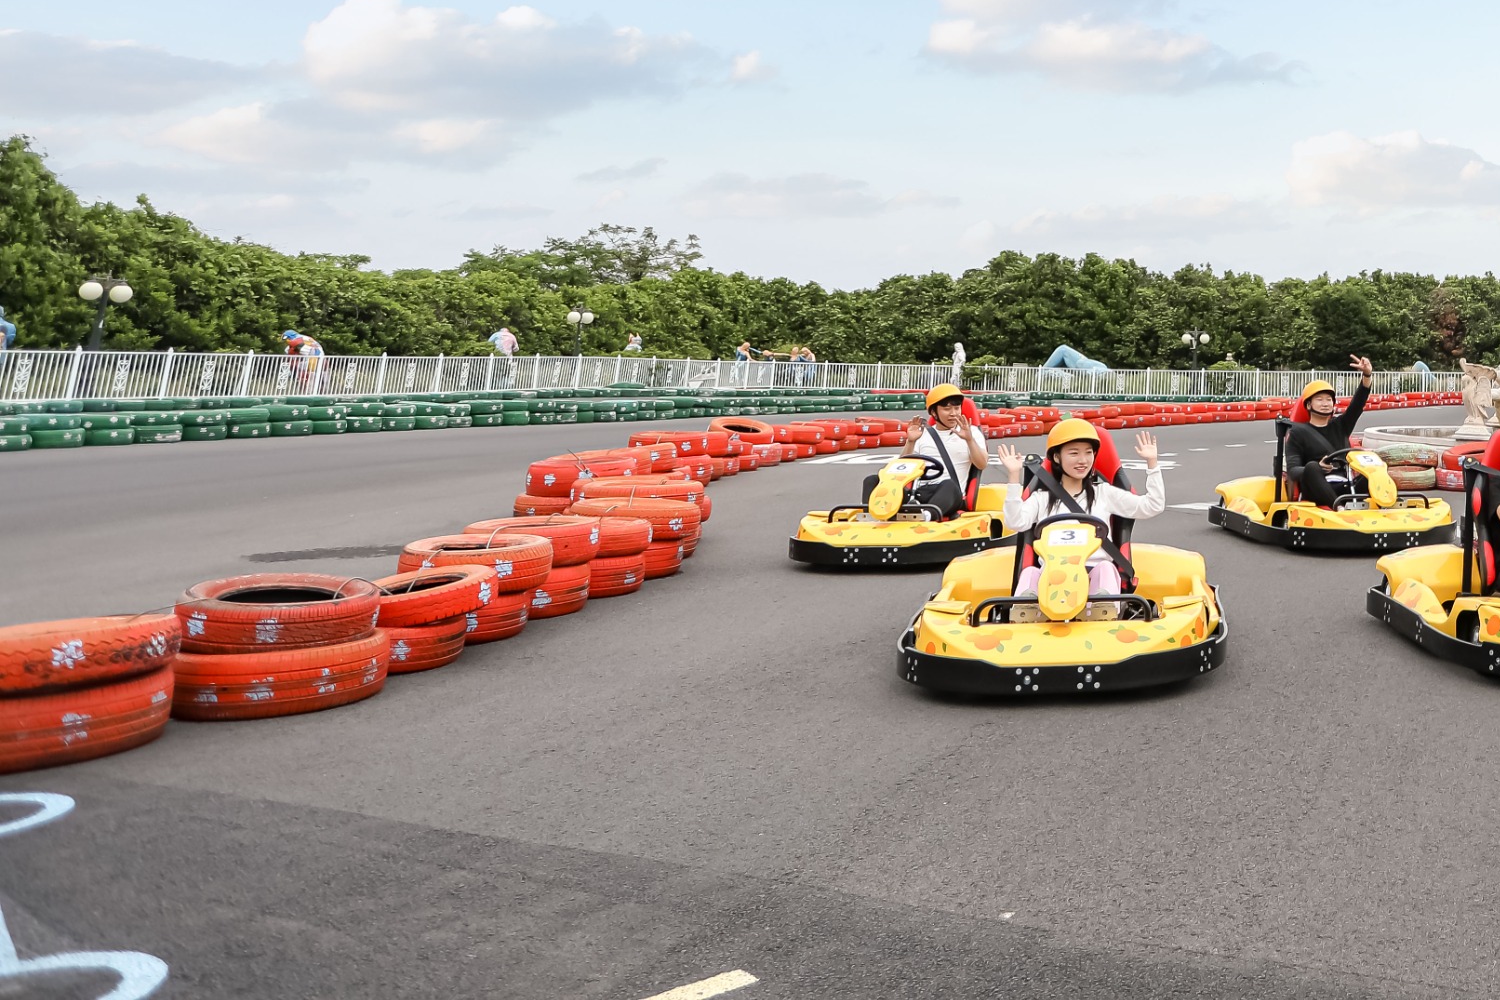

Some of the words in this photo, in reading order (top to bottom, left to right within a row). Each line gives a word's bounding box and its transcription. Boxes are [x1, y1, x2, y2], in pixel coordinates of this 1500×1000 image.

[1362, 455, 1374, 463] 5
[896, 463, 907, 471] 6
[1060, 530, 1076, 541] 3
